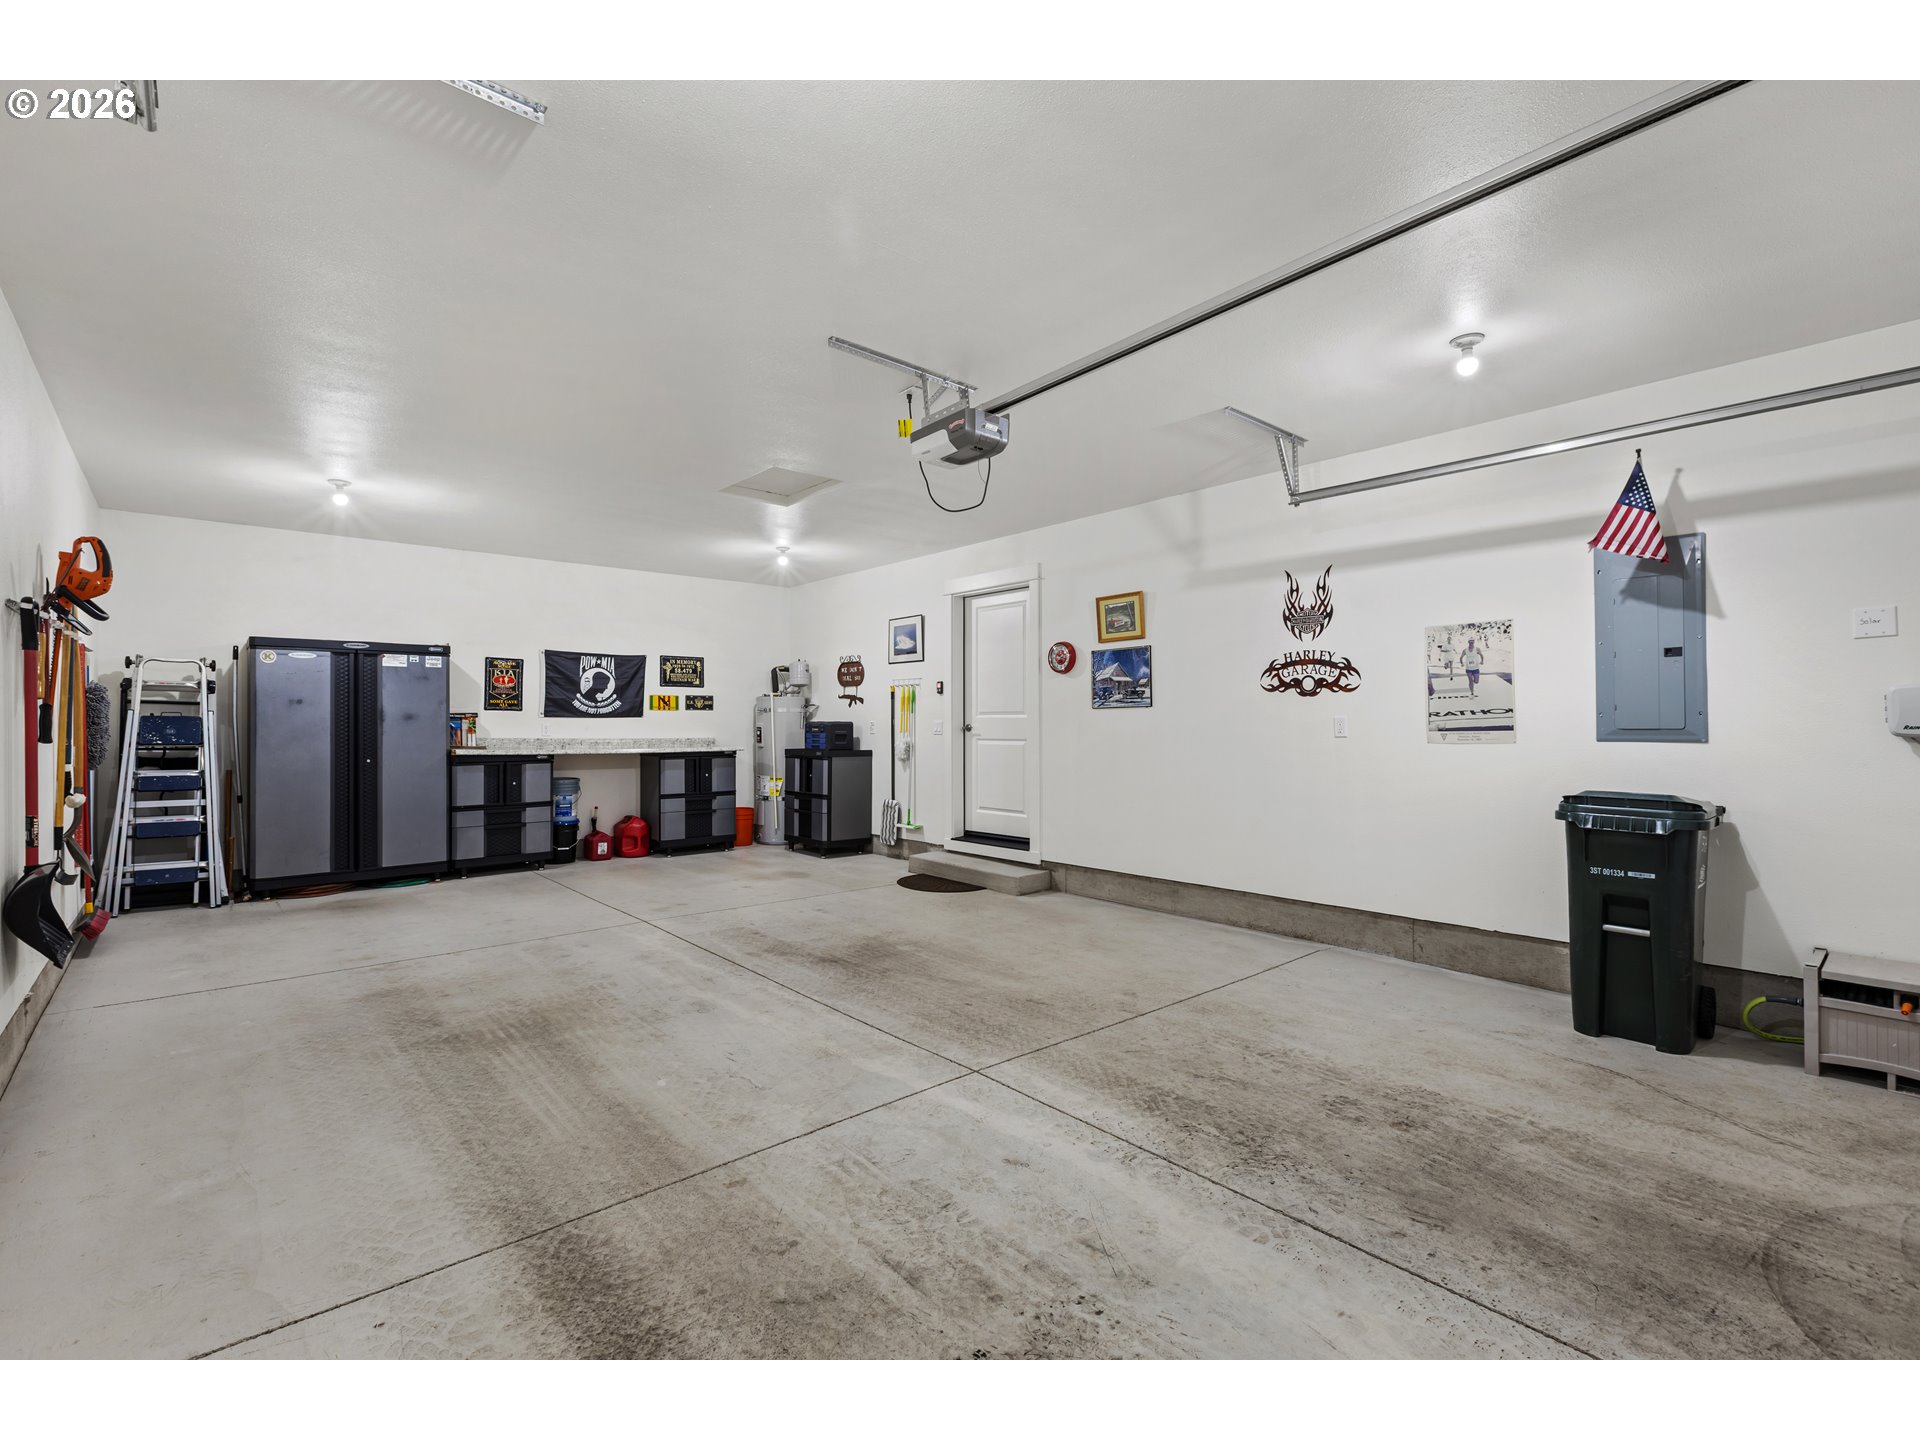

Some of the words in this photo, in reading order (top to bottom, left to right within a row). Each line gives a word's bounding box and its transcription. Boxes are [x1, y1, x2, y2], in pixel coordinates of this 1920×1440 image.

[1859, 617, 1881, 626] Solar
[1283, 649, 1336, 663] HARLEY
[579, 655, 597, 678] POW
[601, 657, 616, 679] MIA
[1281, 664, 1337, 678] GARAGE
[587, 707, 597, 715] NOT
[597, 700, 622, 715] FORGOTTEN
[1589, 866, 1602, 874] 3ST
[1602, 868, 1625, 877] 001334
